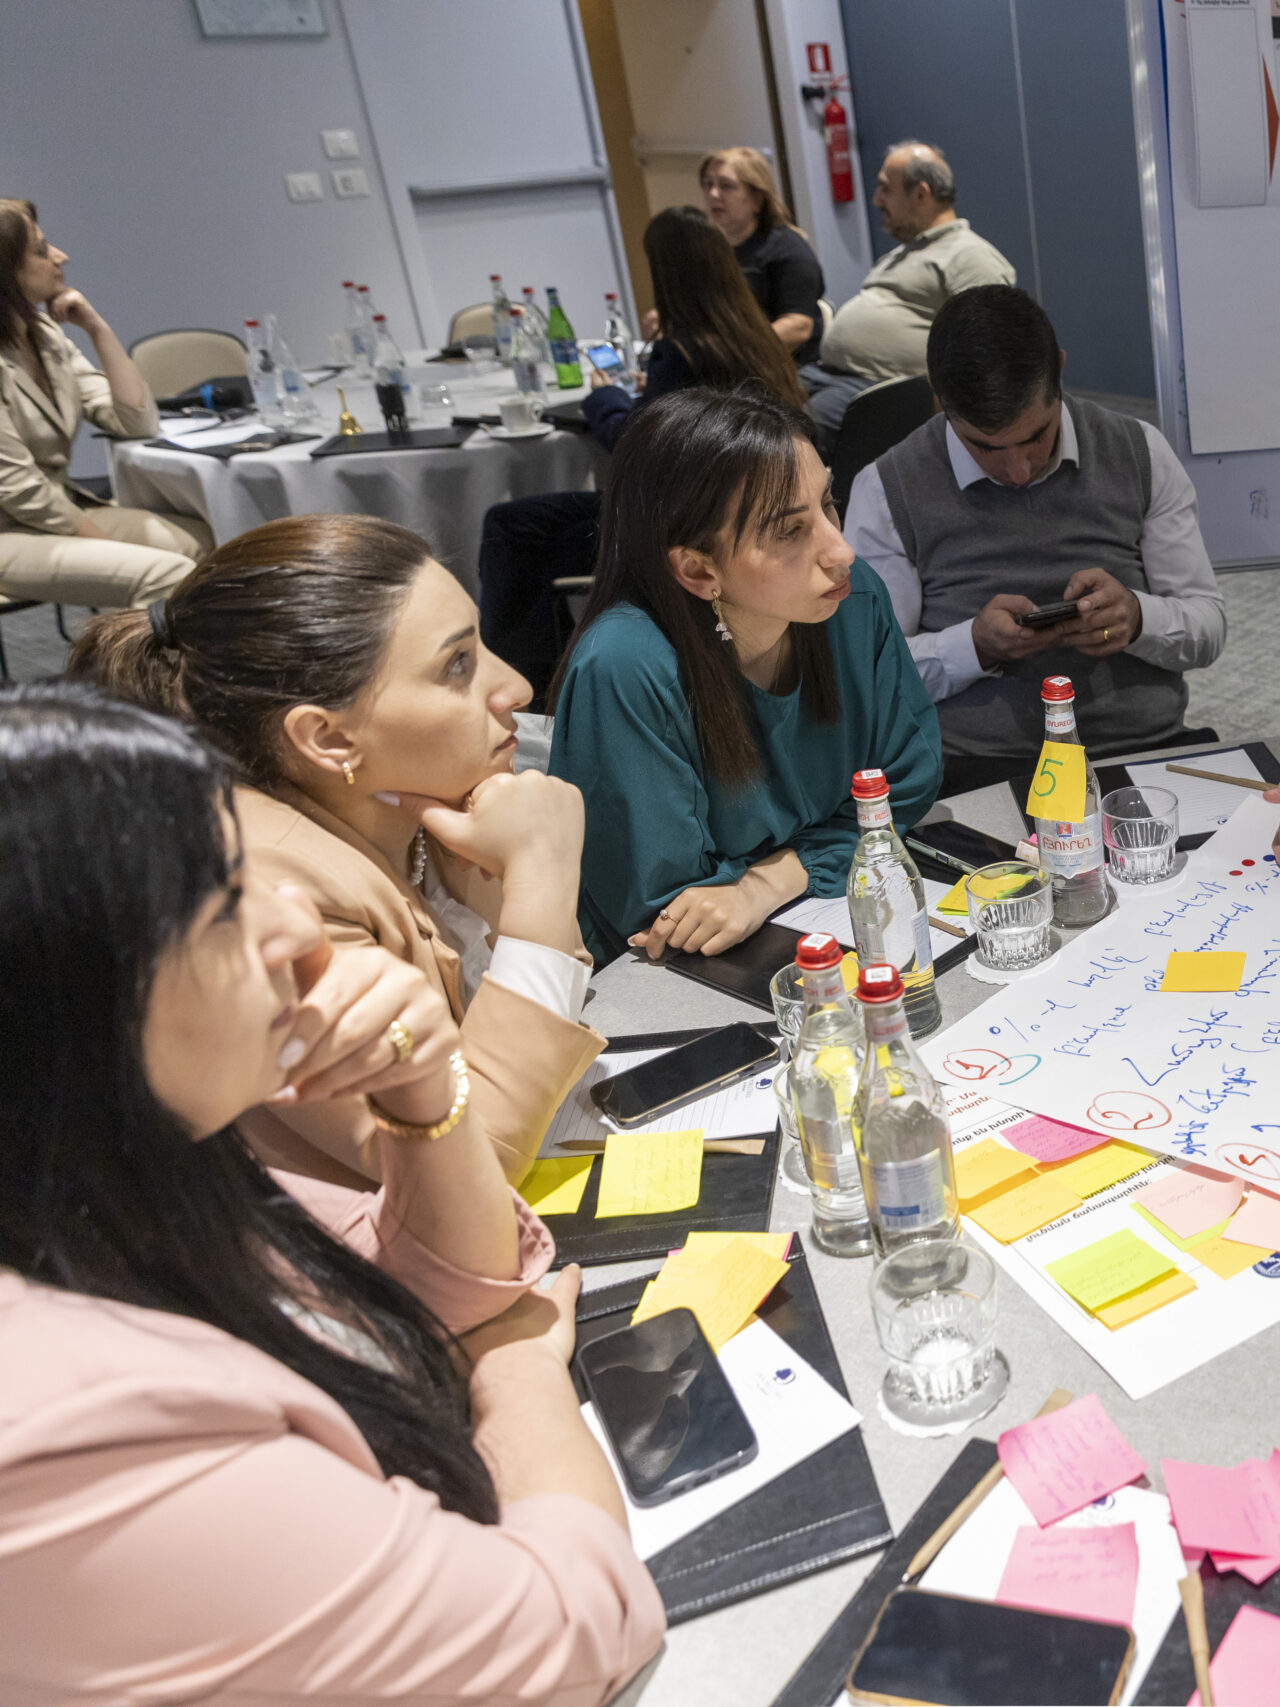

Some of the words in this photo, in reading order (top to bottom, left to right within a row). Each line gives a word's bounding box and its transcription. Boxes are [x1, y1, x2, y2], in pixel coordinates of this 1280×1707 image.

[1033, 758, 1064, 797] 5
[1042, 836, 1092, 850] ԲՅՈՒՐԵՂ
[973, 1127, 988, 1136] են
[988, 1111, 1025, 1132] խնդրի
